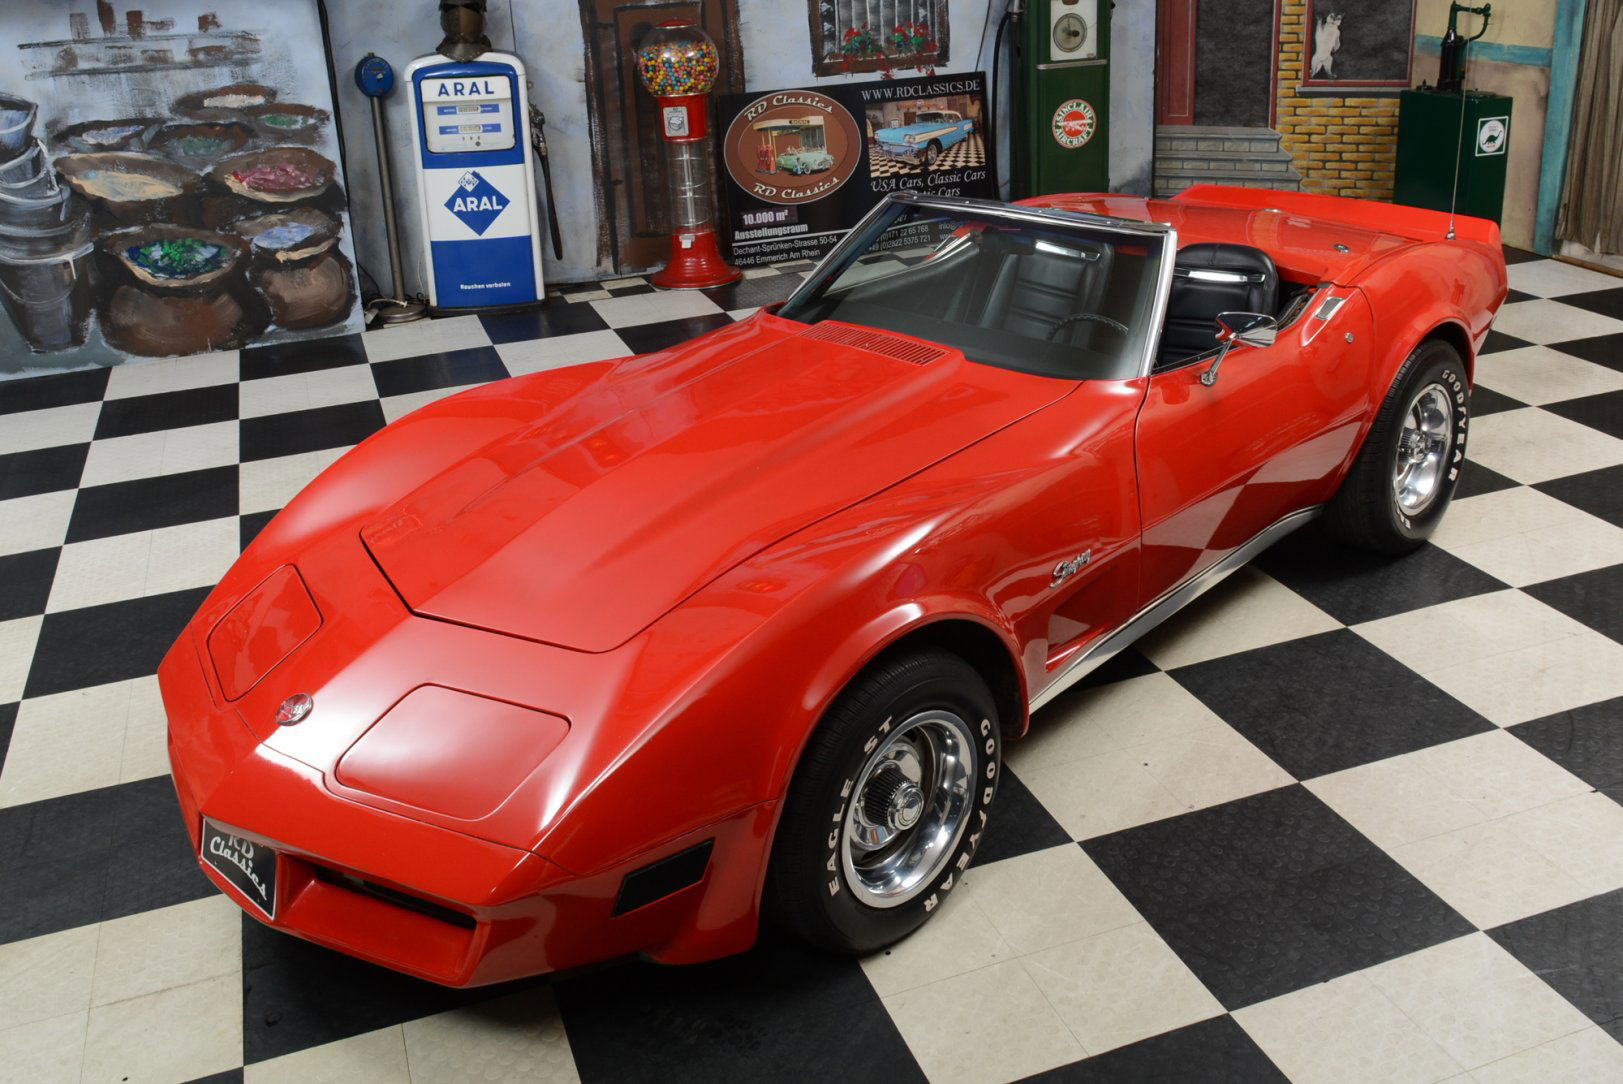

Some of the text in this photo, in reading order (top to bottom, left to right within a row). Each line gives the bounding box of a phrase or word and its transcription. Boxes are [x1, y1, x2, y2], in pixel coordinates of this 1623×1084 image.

[438, 80, 495, 97] ARAL
[861, 80, 980, 101] WWW.RDCLASSICS.DE
[744, 94, 833, 121] RD Classics
[1056, 102, 1093, 121] SINCLAIR
[1055, 124, 1092, 146] AIRCRAFT
[753, 176, 840, 199] RD Classics
[870, 169, 987, 192] USA Cars, Classic Cars
[938, 186, 961, 197] Cars
[453, 195, 503, 212] ARAL
[743, 211, 775, 226] 10.000
[734, 223, 809, 241] Ausstellungsraum
[789, 251, 801, 260] Am
[801, 248, 821, 258] Rhein
[1441, 369, 1467, 482] GOODYEAR
[826, 715, 893, 897] EAGLE ST
[924, 718, 996, 912] GOODYEAR
[210, 836, 268, 901] Classics
